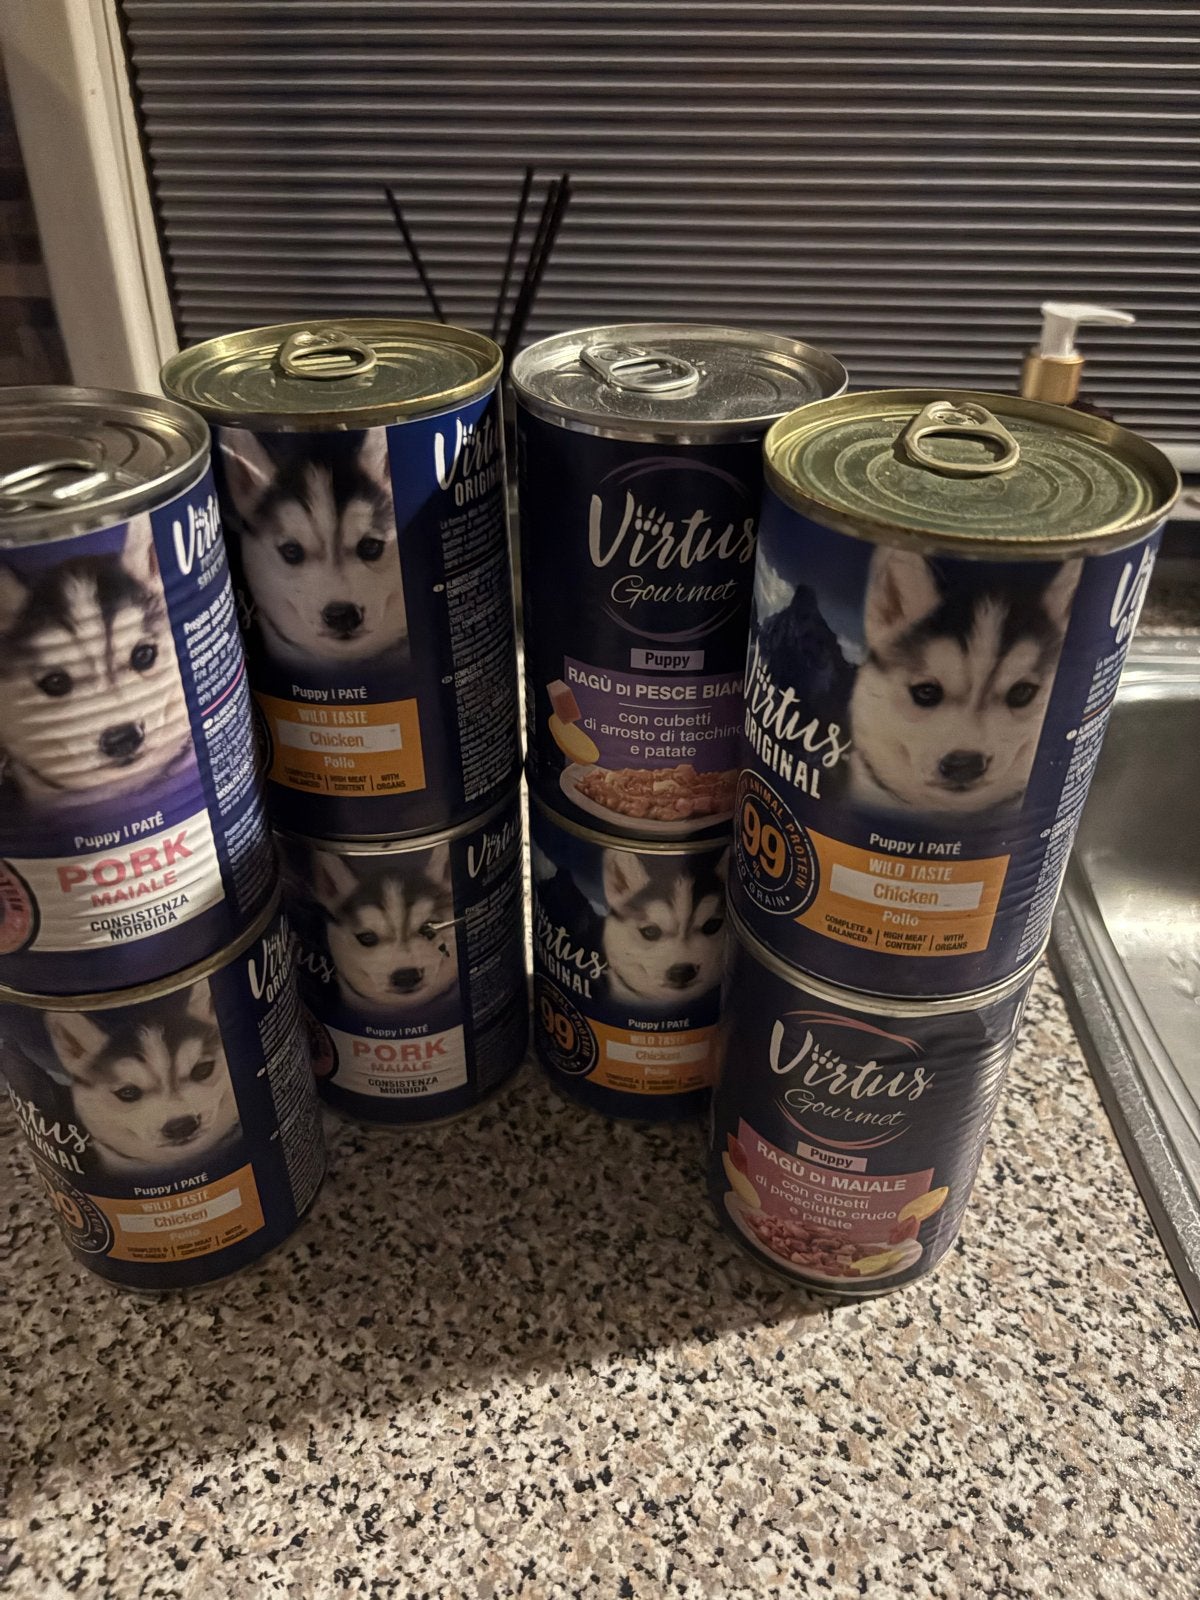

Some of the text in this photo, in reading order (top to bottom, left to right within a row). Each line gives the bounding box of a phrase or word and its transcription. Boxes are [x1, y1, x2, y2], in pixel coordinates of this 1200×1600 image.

[588, 488, 757, 570] Virtus
[610, 574, 738, 610] Gourmet
[644, 651, 690, 669] Puppy
[292, 684, 368, 701] Puppy PATÉ
[568, 666, 743, 700] RAGÙ DI PESCE BIAN
[298, 708, 368, 724] WILD TASTE
[618, 712, 711, 727] con cubetti
[309, 731, 364, 748] Chicken
[584, 717, 597, 731] di
[600, 724, 655, 742] arrosto
[660, 728, 675, 742] di
[323, 756, 356, 769] Pollo
[630, 745, 697, 759] e patate
[744, 707, 821, 800] ORIGINAL
[380, 773, 400, 782] WITH
[74, 811, 165, 849] Puppy PATÉ
[741, 801, 787, 879] 99
[869, 833, 962, 855] Puppy PATÉ
[56, 829, 193, 893] PORK
[785, 822, 808, 890] PROTEIN
[868, 858, 954, 881] WILD TASTE
[90, 870, 178, 908] MAIALE
[873, 882, 939, 906] Chicken
[90, 894, 189, 932] CONSISTENZA
[825, 914, 873, 935] COMPLETE &
[882, 910, 920, 927] Pollo
[110, 911, 178, 941] MORBIDA
[827, 924, 868, 943] BALANCED
[883, 930, 928, 942] HIGH MEAT
[943, 933, 964, 942] WITH
[885, 939, 923, 951] CONTENT
[935, 941, 968, 951] ORGANS
[365, 1024, 429, 1038] Puppy PATÉ
[539, 996, 575, 1051] 99
[627, 1018, 660, 1031] Puppy
[352, 1037, 448, 1063] PORK
[769, 1019, 937, 1101] Virtus
[371, 1060, 433, 1073] MAIALE
[368, 1076, 439, 1088] CONSISTENZA
[784, 1088, 907, 1127] Gourmet
[756, 1140, 908, 1194] RAGÙ DI MAIALE
[810, 1147, 853, 1169] Puppy
[133, 1172, 209, 1197] Puppy PATÉ
[781, 1179, 870, 1210] con cubetti
[755, 1174, 897, 1221] di prosciutto crudo
[153, 1208, 208, 1228] Chicken
[789, 1205, 852, 1230] e patate
